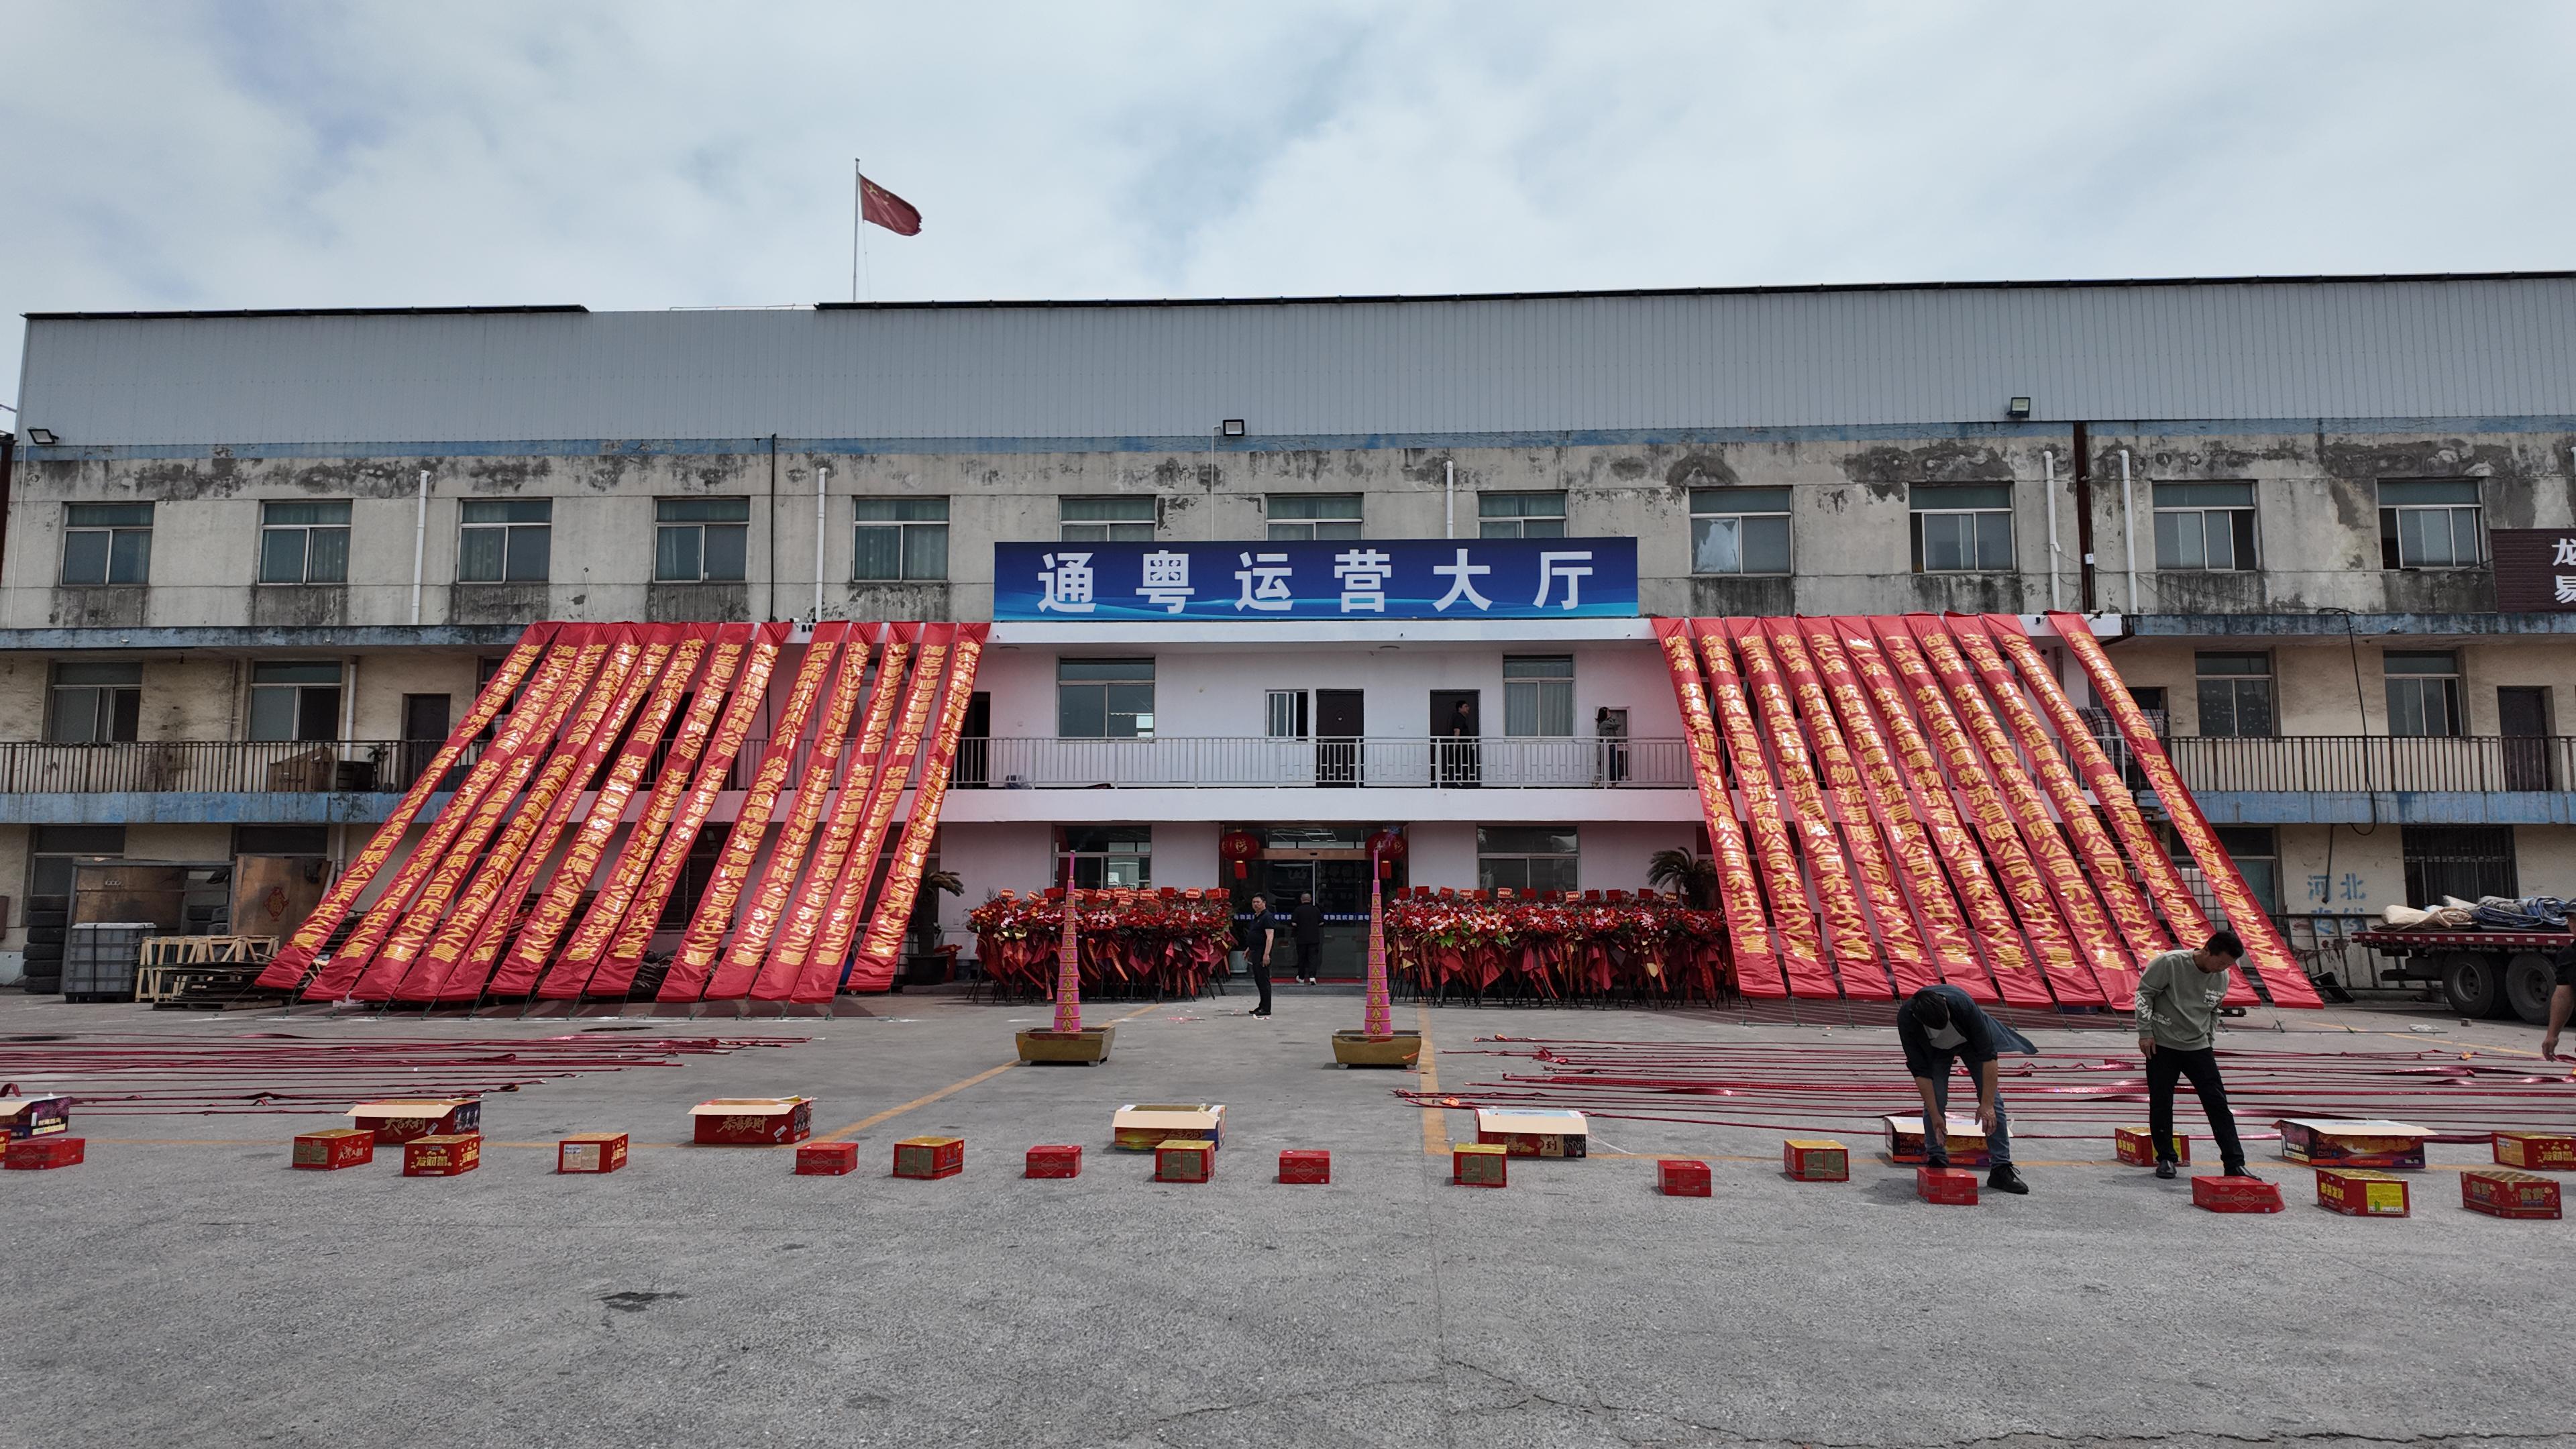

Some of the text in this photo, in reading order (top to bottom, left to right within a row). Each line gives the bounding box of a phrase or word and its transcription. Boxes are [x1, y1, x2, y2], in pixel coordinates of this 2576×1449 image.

[1038, 548, 1593, 614] 通粤运营大厅
[1776, 634, 1813, 673] 杨长余
[1680, 683, 1769, 955] 祝海安通粤物流有限公司乔迁之喜
[1718, 684, 1817, 962] 祝海安通粤物流有限公司乔迁之喜
[1760, 684, 1873, 960] 祝海安通粤物流有限公司乔迁之喜
[1835, 684, 1971, 965] 祝海安通粤物流有限公司乔迁之喜
[1874, 686, 2026, 969] 祝海安通粤物流有限公司乔迁之喜
[1886, 635, 2076, 969] 丁兴旺 祝海安通粤物流有限公司乔迁之喜
[1925, 633, 2125, 971] 胡志祥 祝海安通粤物流有限公司乔迁之喜
[2096, 773, 2208, 950] 祝海安通粤物流有限公司乔迁
[2307, 873, 2367, 902] 河北
[716, 1114, 768, 1134] 恭喜发财
